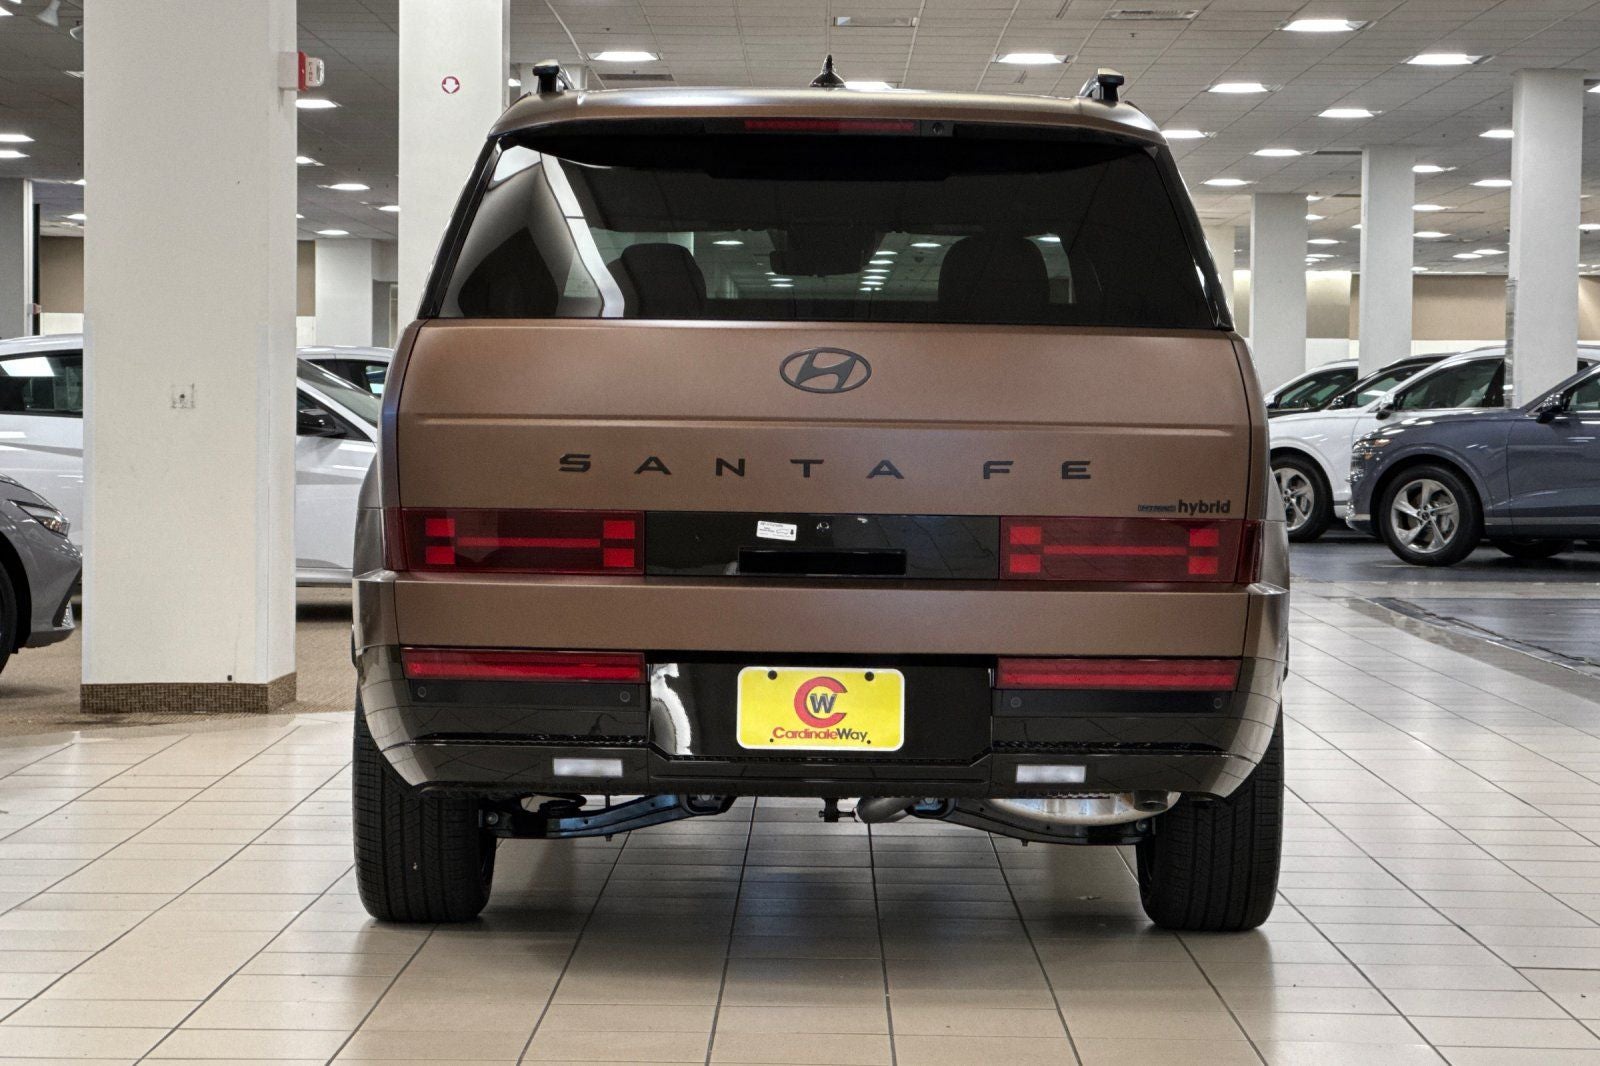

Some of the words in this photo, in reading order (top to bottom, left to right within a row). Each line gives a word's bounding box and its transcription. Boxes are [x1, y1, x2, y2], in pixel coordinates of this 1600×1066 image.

[558, 453, 904, 480] SANTA
[983, 460, 1091, 480] FE
[1178, 499, 1231, 516] hybrid
